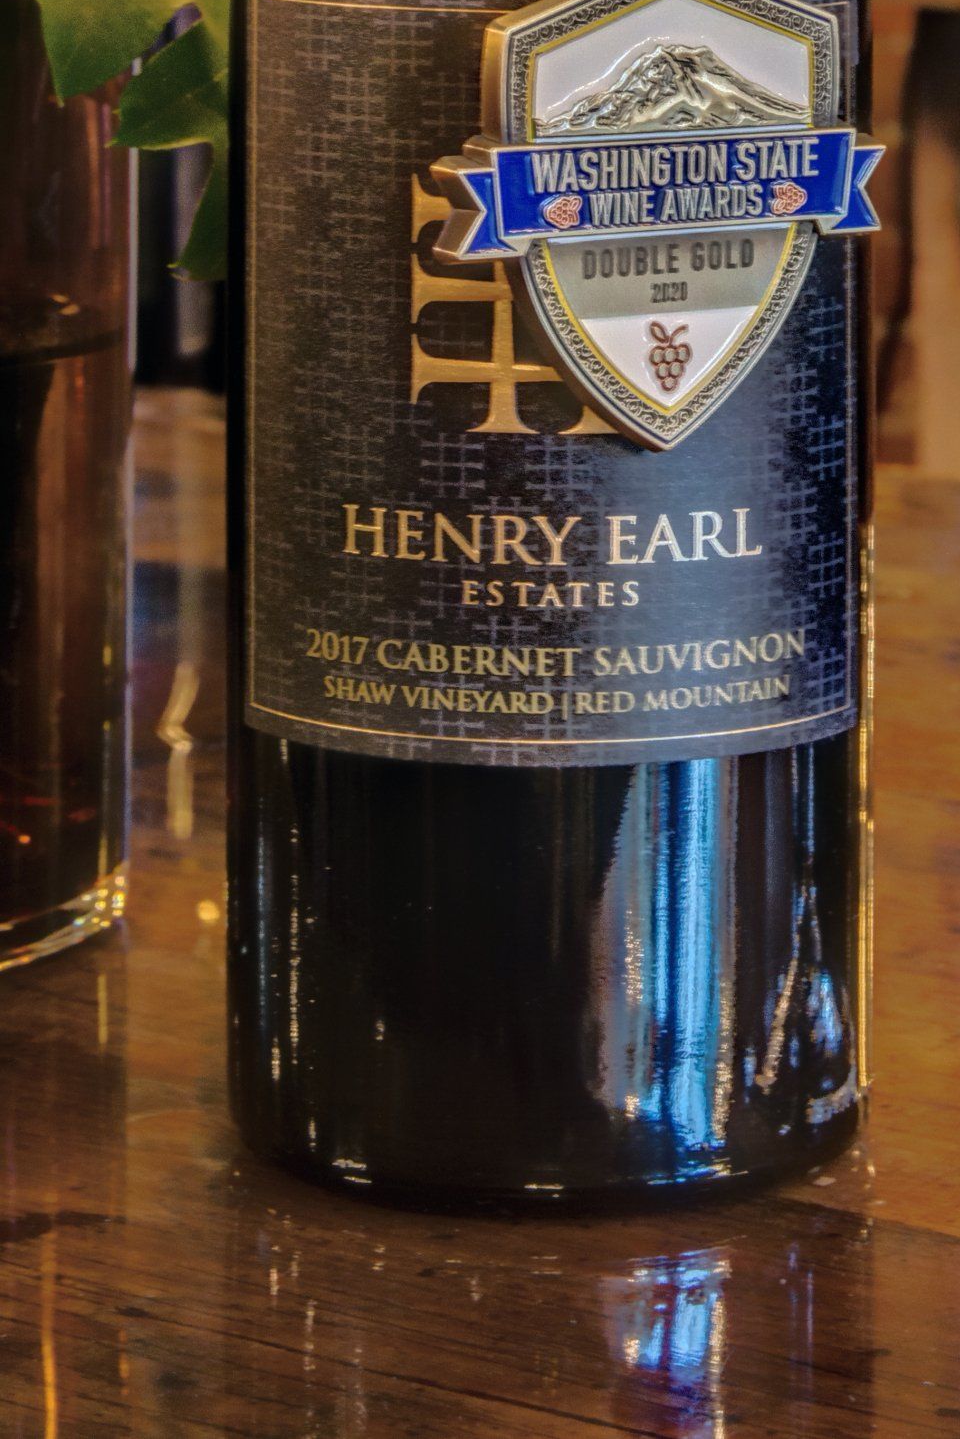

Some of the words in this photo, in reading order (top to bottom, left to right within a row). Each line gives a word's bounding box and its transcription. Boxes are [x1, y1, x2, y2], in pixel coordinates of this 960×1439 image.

[530, 142, 728, 194] WASHINGTON
[736, 138, 819, 180] STATE
[589, 190, 655, 227] WINE
[660, 182, 765, 222] AWARDS
[582, 245, 680, 281] DOUBLE
[690, 238, 756, 273] GOLD
[649, 280, 689, 304] 2020
[341, 503, 583, 566] HENRY
[605, 507, 763, 565] EARL
[461, 580, 640, 608] ESTATES
[305, 628, 371, 664] 2017
[375, 639, 582, 678] CABERNET
[593, 629, 805, 677] SAUVIGNON
[324, 675, 397, 704] SHAW
[398, 685, 554, 716] VINEYARD
[574, 687, 636, 715] RED
[642, 674, 791, 712] MOUNTAIN
